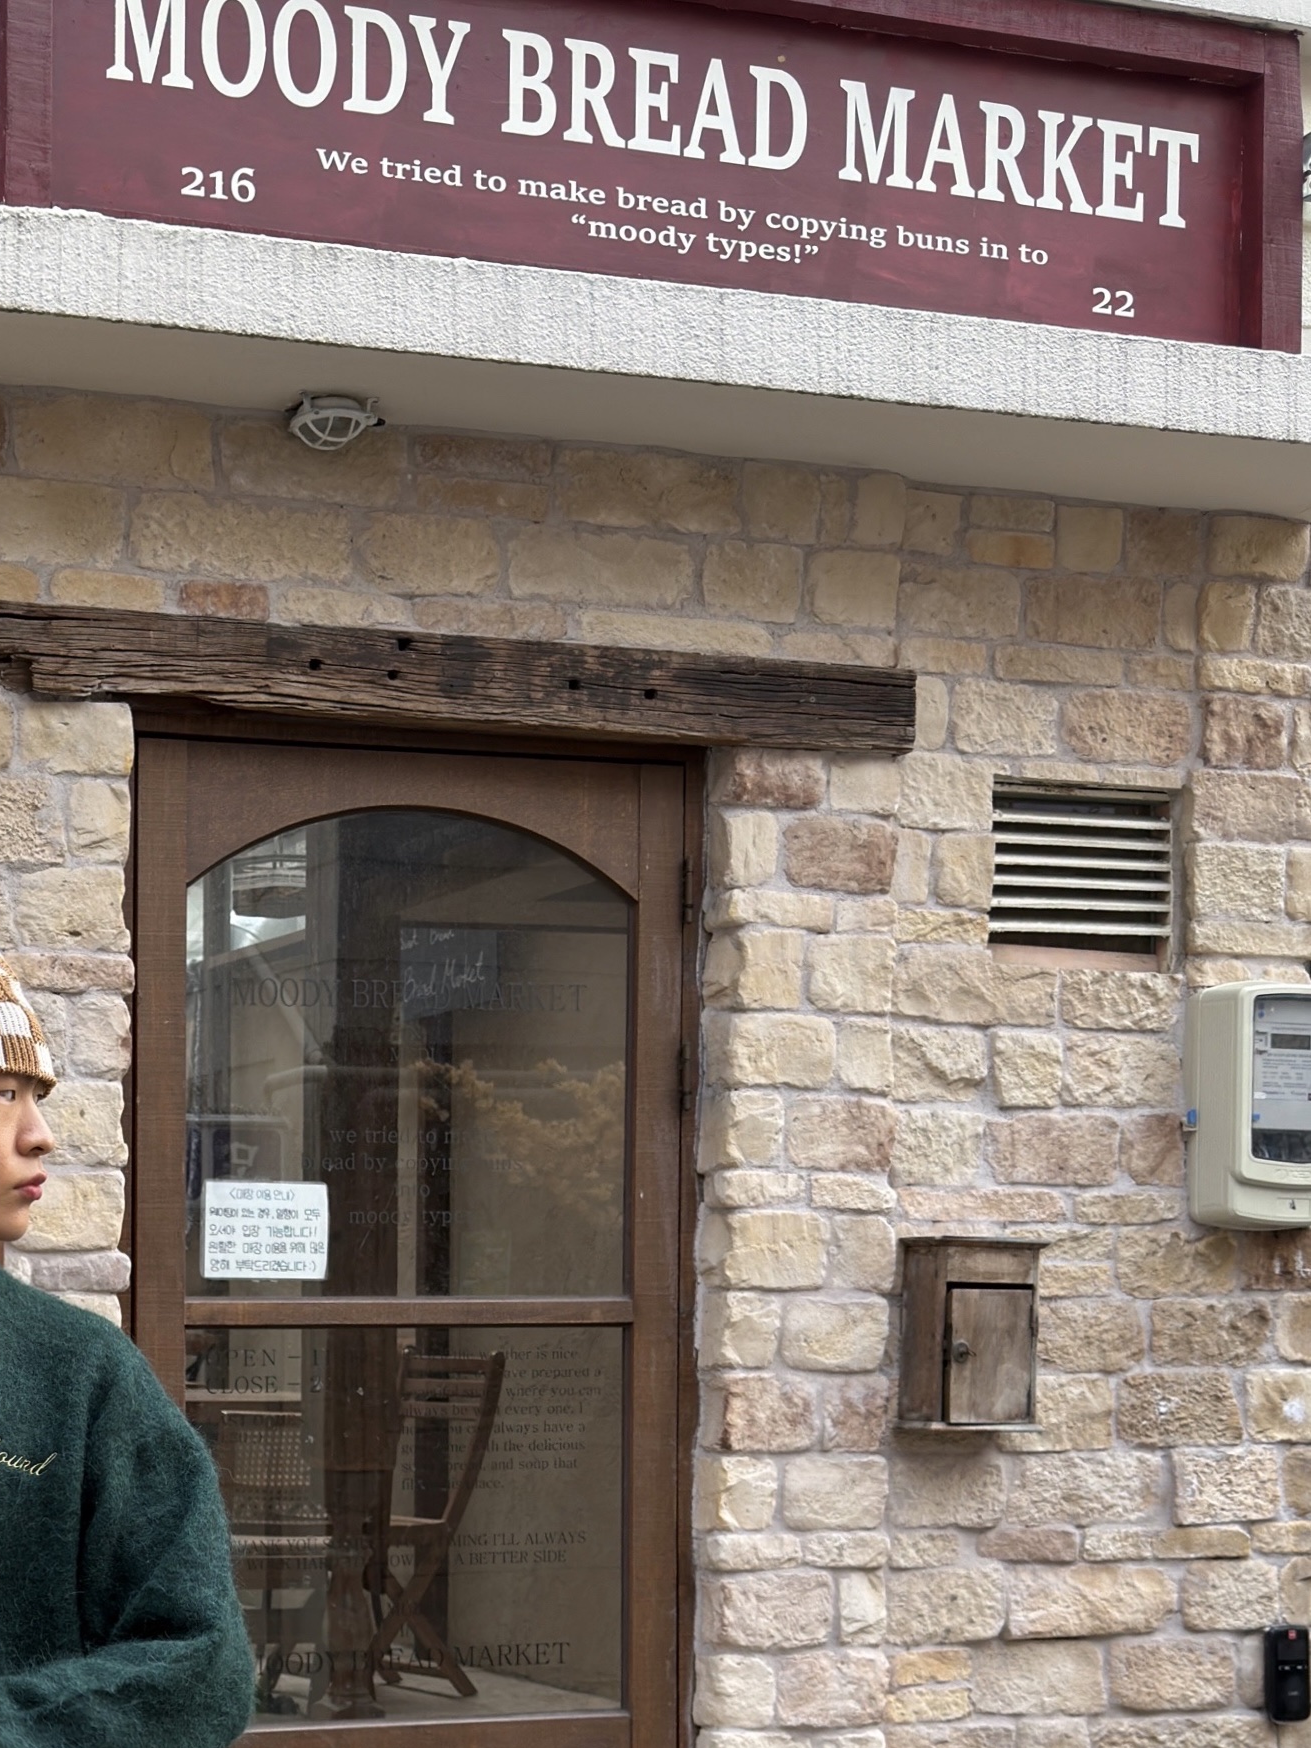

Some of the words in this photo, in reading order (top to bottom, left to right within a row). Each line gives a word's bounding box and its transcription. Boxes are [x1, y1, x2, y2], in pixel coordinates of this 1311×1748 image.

[106, 0, 470, 125] MOODY
[501, 29, 807, 170] BREAD
[839, 79, 1199, 228] MARKET
[181, 167, 255, 203] 216
[316, 148, 368, 174] We
[380, 158, 463, 186] tried
[473, 169, 506, 192] to
[518, 179, 605, 205] make
[616, 187, 708, 218] bread
[718, 200, 756, 231] by
[766, 213, 887, 249] copying
[896, 225, 969, 255] buns
[980, 236, 1009, 260] in
[1018, 244, 1049, 265] to
[572, 213, 696, 254] “moody
[706, 233, 819, 264] types!”
[1092, 287, 1134, 317] 22
[233, 978, 337, 1008] MOODY
[463, 982, 588, 1012] MARKET
[304, 1208, 321, 1221] 모두
[241, 1224, 260, 1238] 입장
[242, 1242, 263, 1255] 매장
[552, 1346, 579, 1361] nice
[531, 1365, 590, 1381] prepared
[504, 1405, 542, 1417] every
[493, 1420, 539, 1434] always
[543, 1420, 575, 1433] have
[503, 1439, 525, 1452] the
[528, 1438, 587, 1452] delicious
[490, 1457, 515, 1471] and
[553, 1456, 579, 1470] that
[525, 1531, 587, 1545] ALWAYS
[469, 1551, 529, 1566] BETTER
[533, 1549, 567, 1563] SIDE
[352, 1646, 446, 1672] BEAD
[453, 1641, 571, 1668] MARKET
